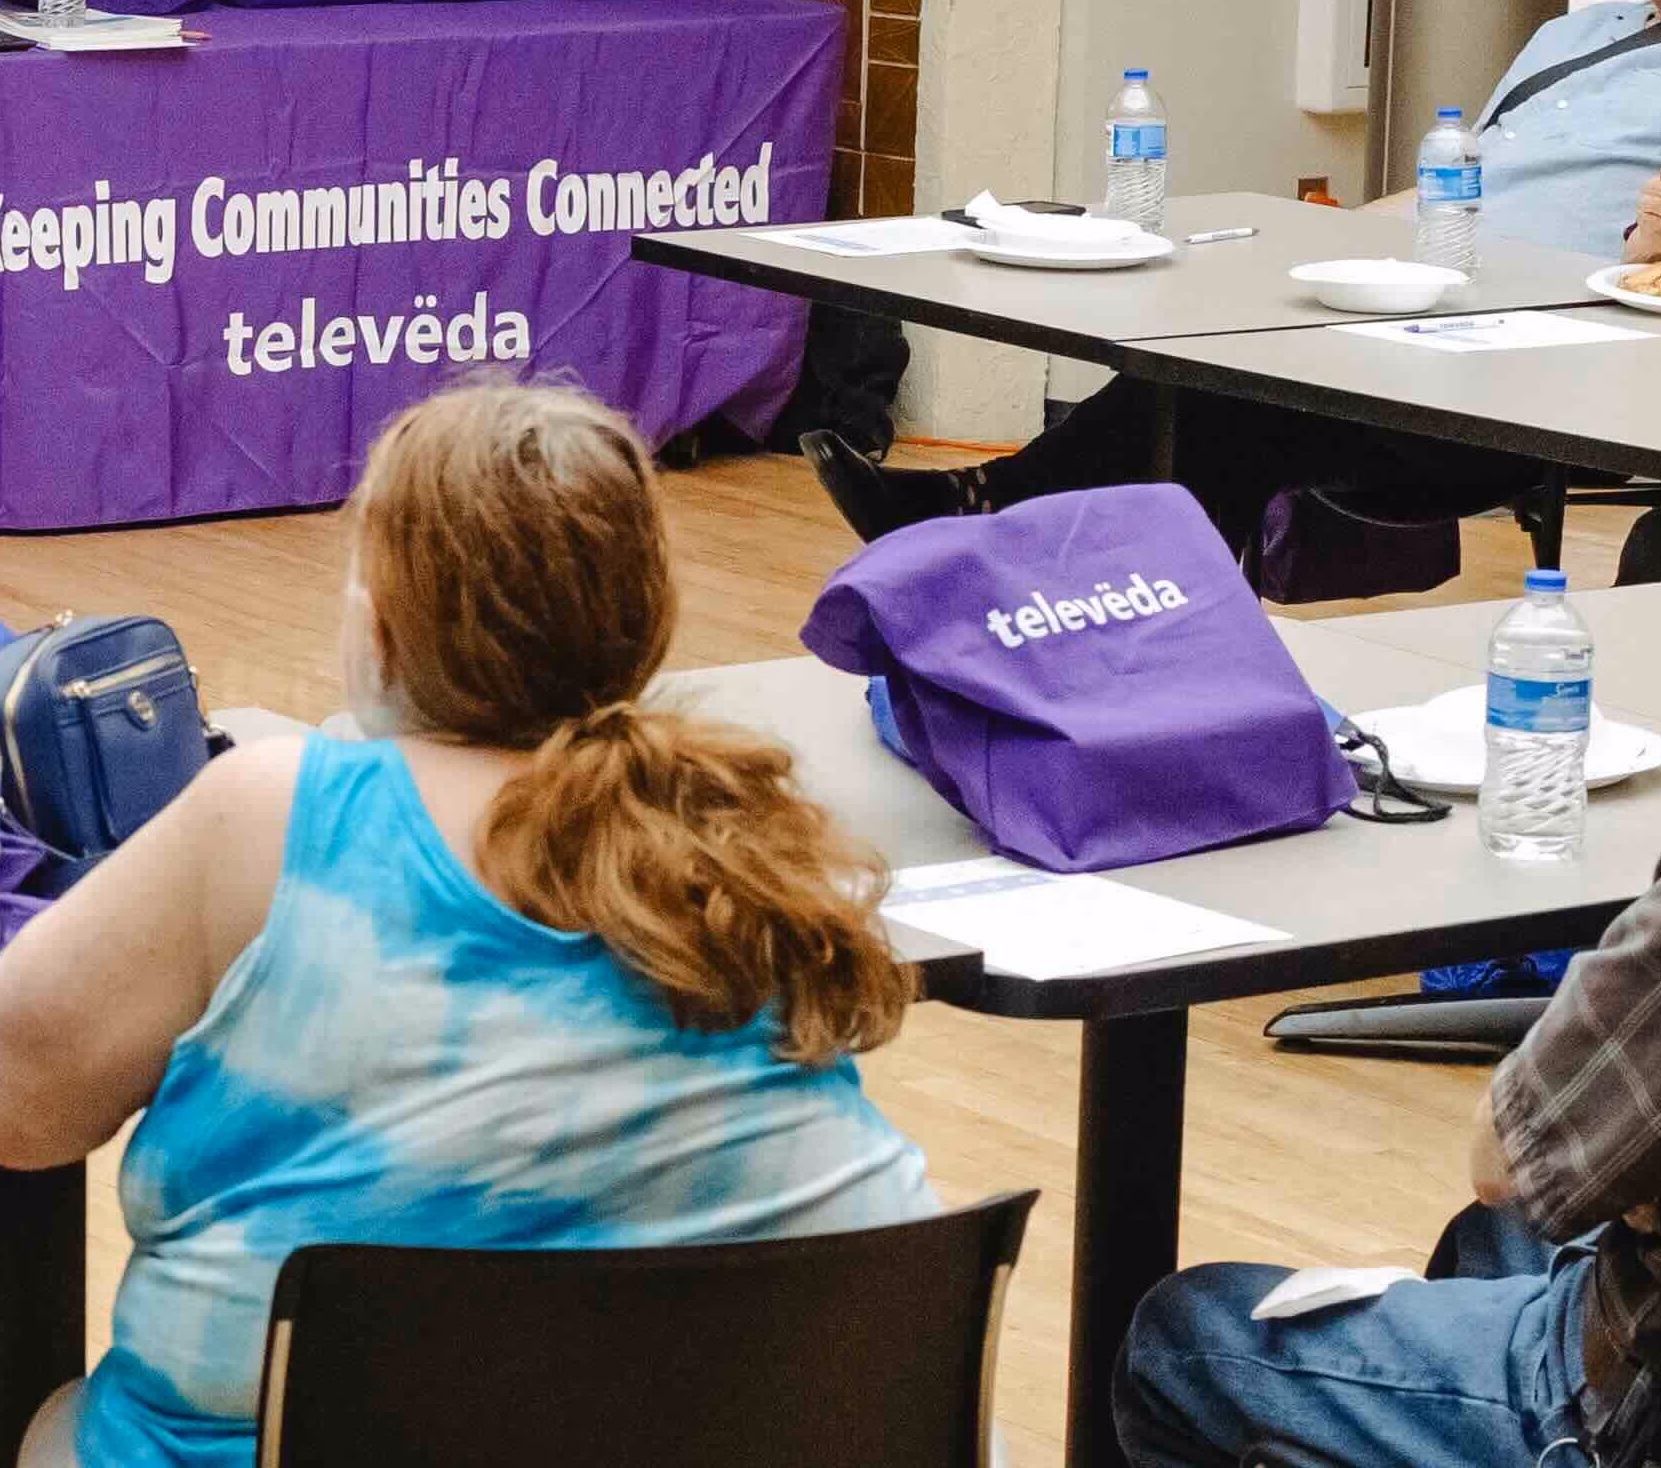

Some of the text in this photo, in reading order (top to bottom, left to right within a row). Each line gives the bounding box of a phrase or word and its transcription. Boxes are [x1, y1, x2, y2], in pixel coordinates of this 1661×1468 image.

[190, 156, 514, 258] Communities
[526, 142, 773, 236] Connected
[223, 290, 531, 377] televëda
[987, 572, 1189, 648] televëda
